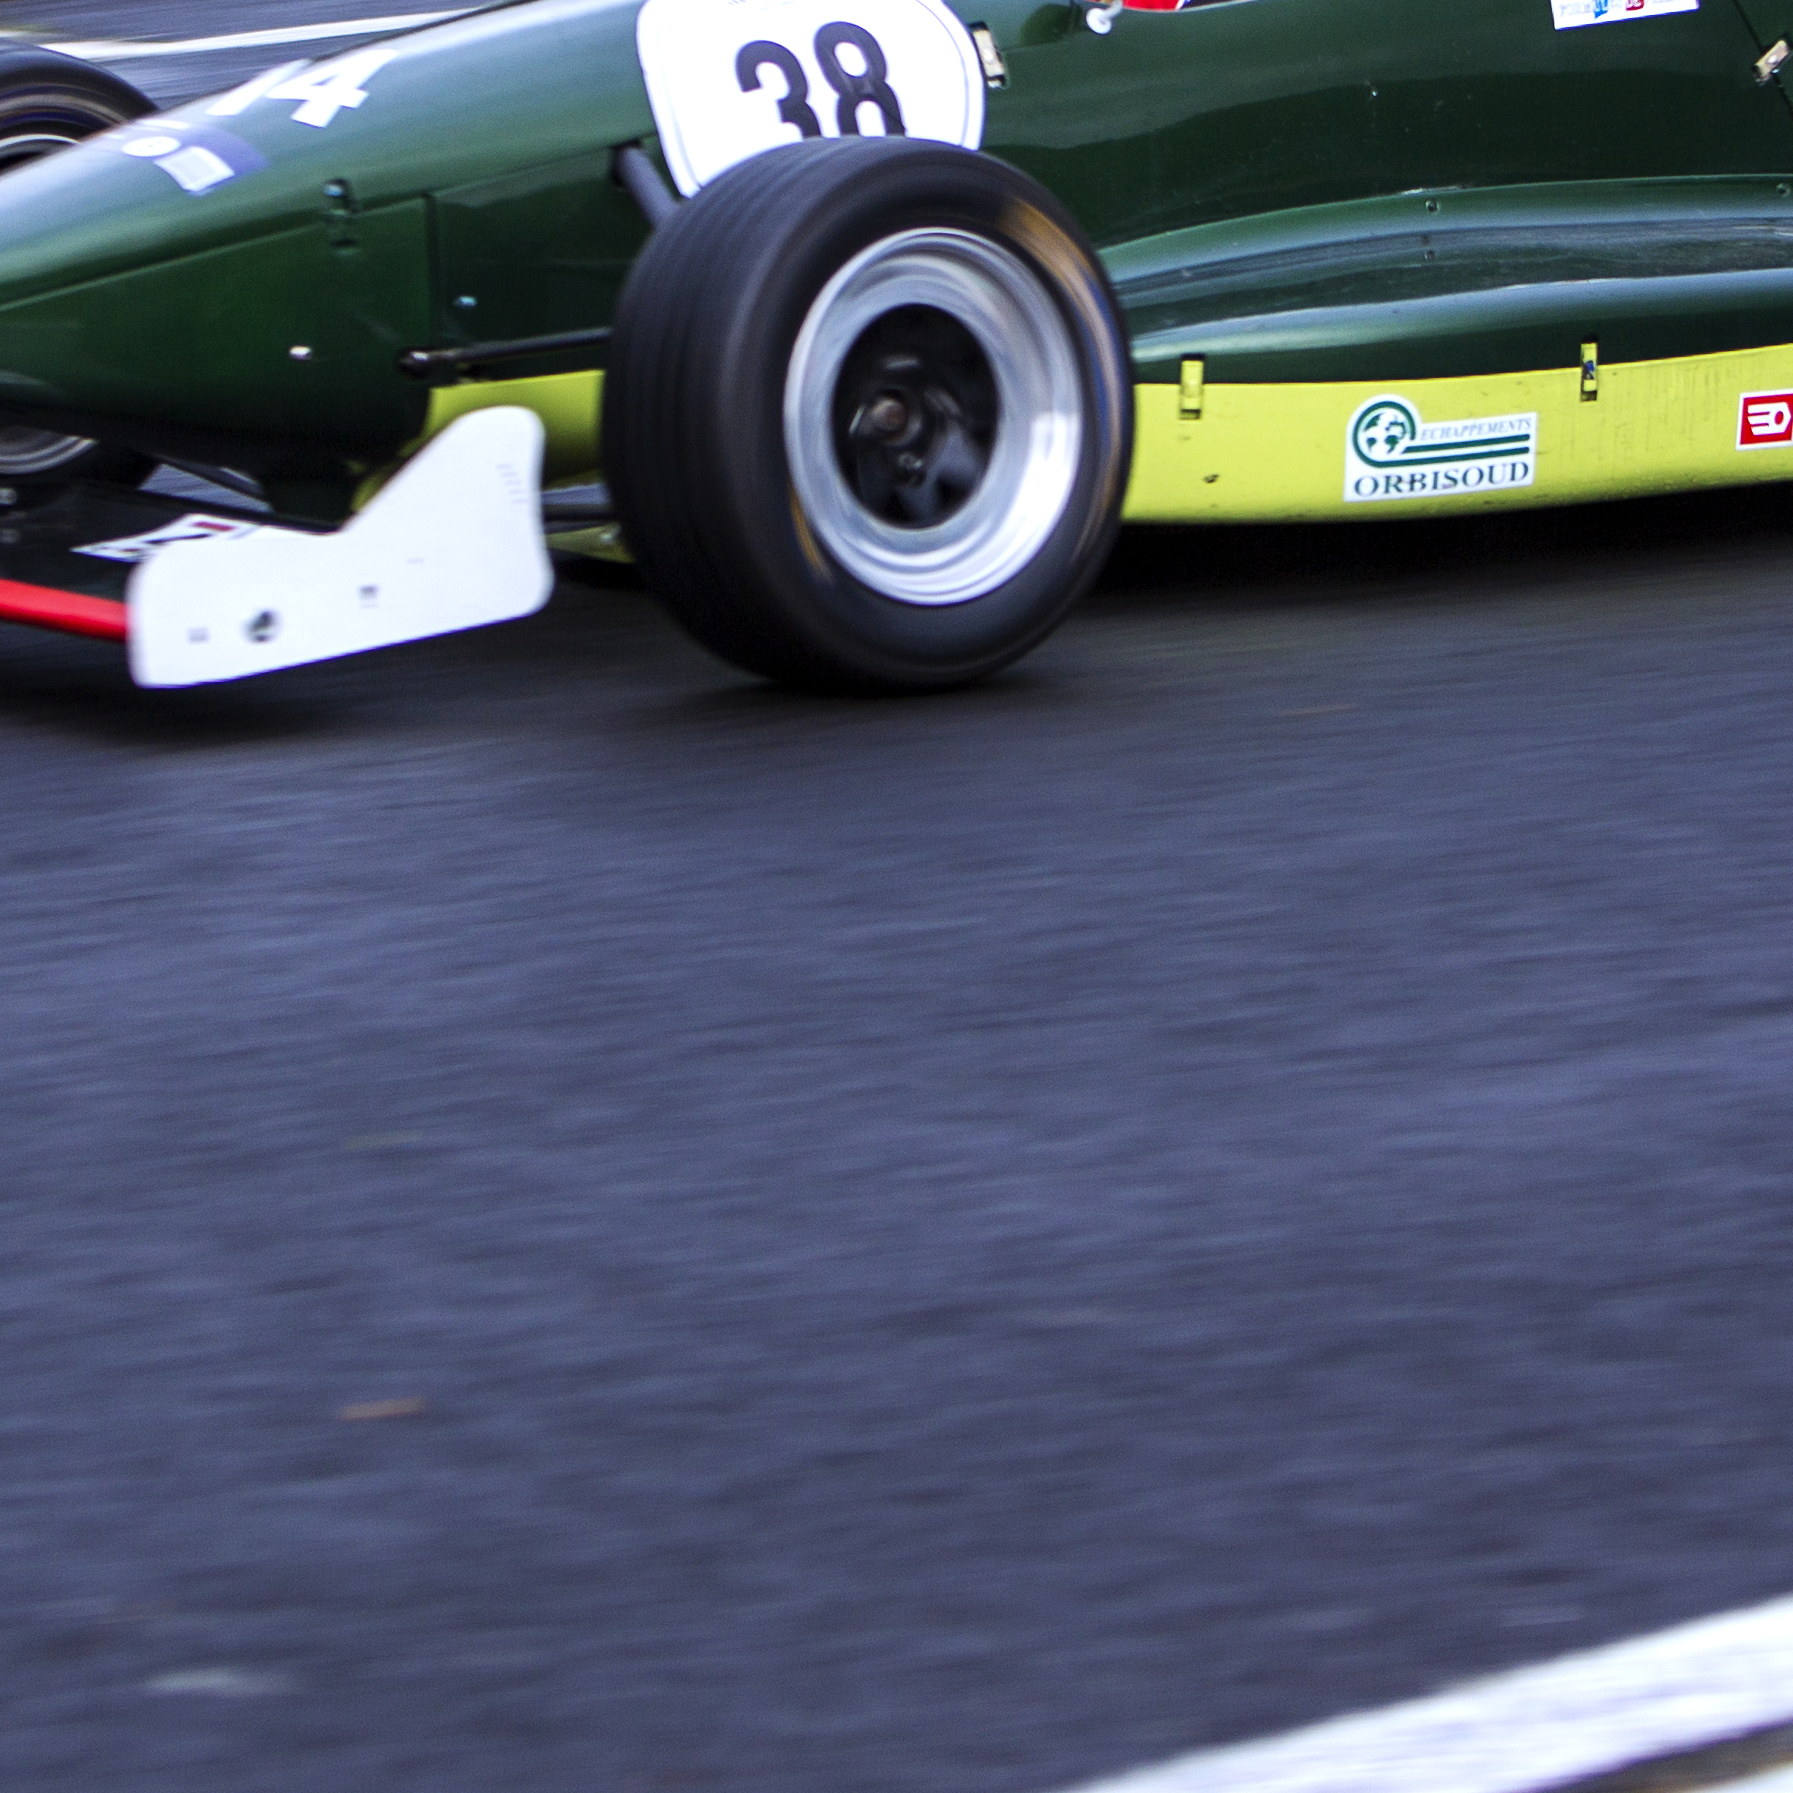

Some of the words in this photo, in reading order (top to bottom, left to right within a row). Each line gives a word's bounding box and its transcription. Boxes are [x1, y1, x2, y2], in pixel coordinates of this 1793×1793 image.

[735, 21, 907, 137] 38
[1420, 417, 1532, 441] ECHAPPEMENTS
[1354, 461, 1530, 497] ORBISOUD
